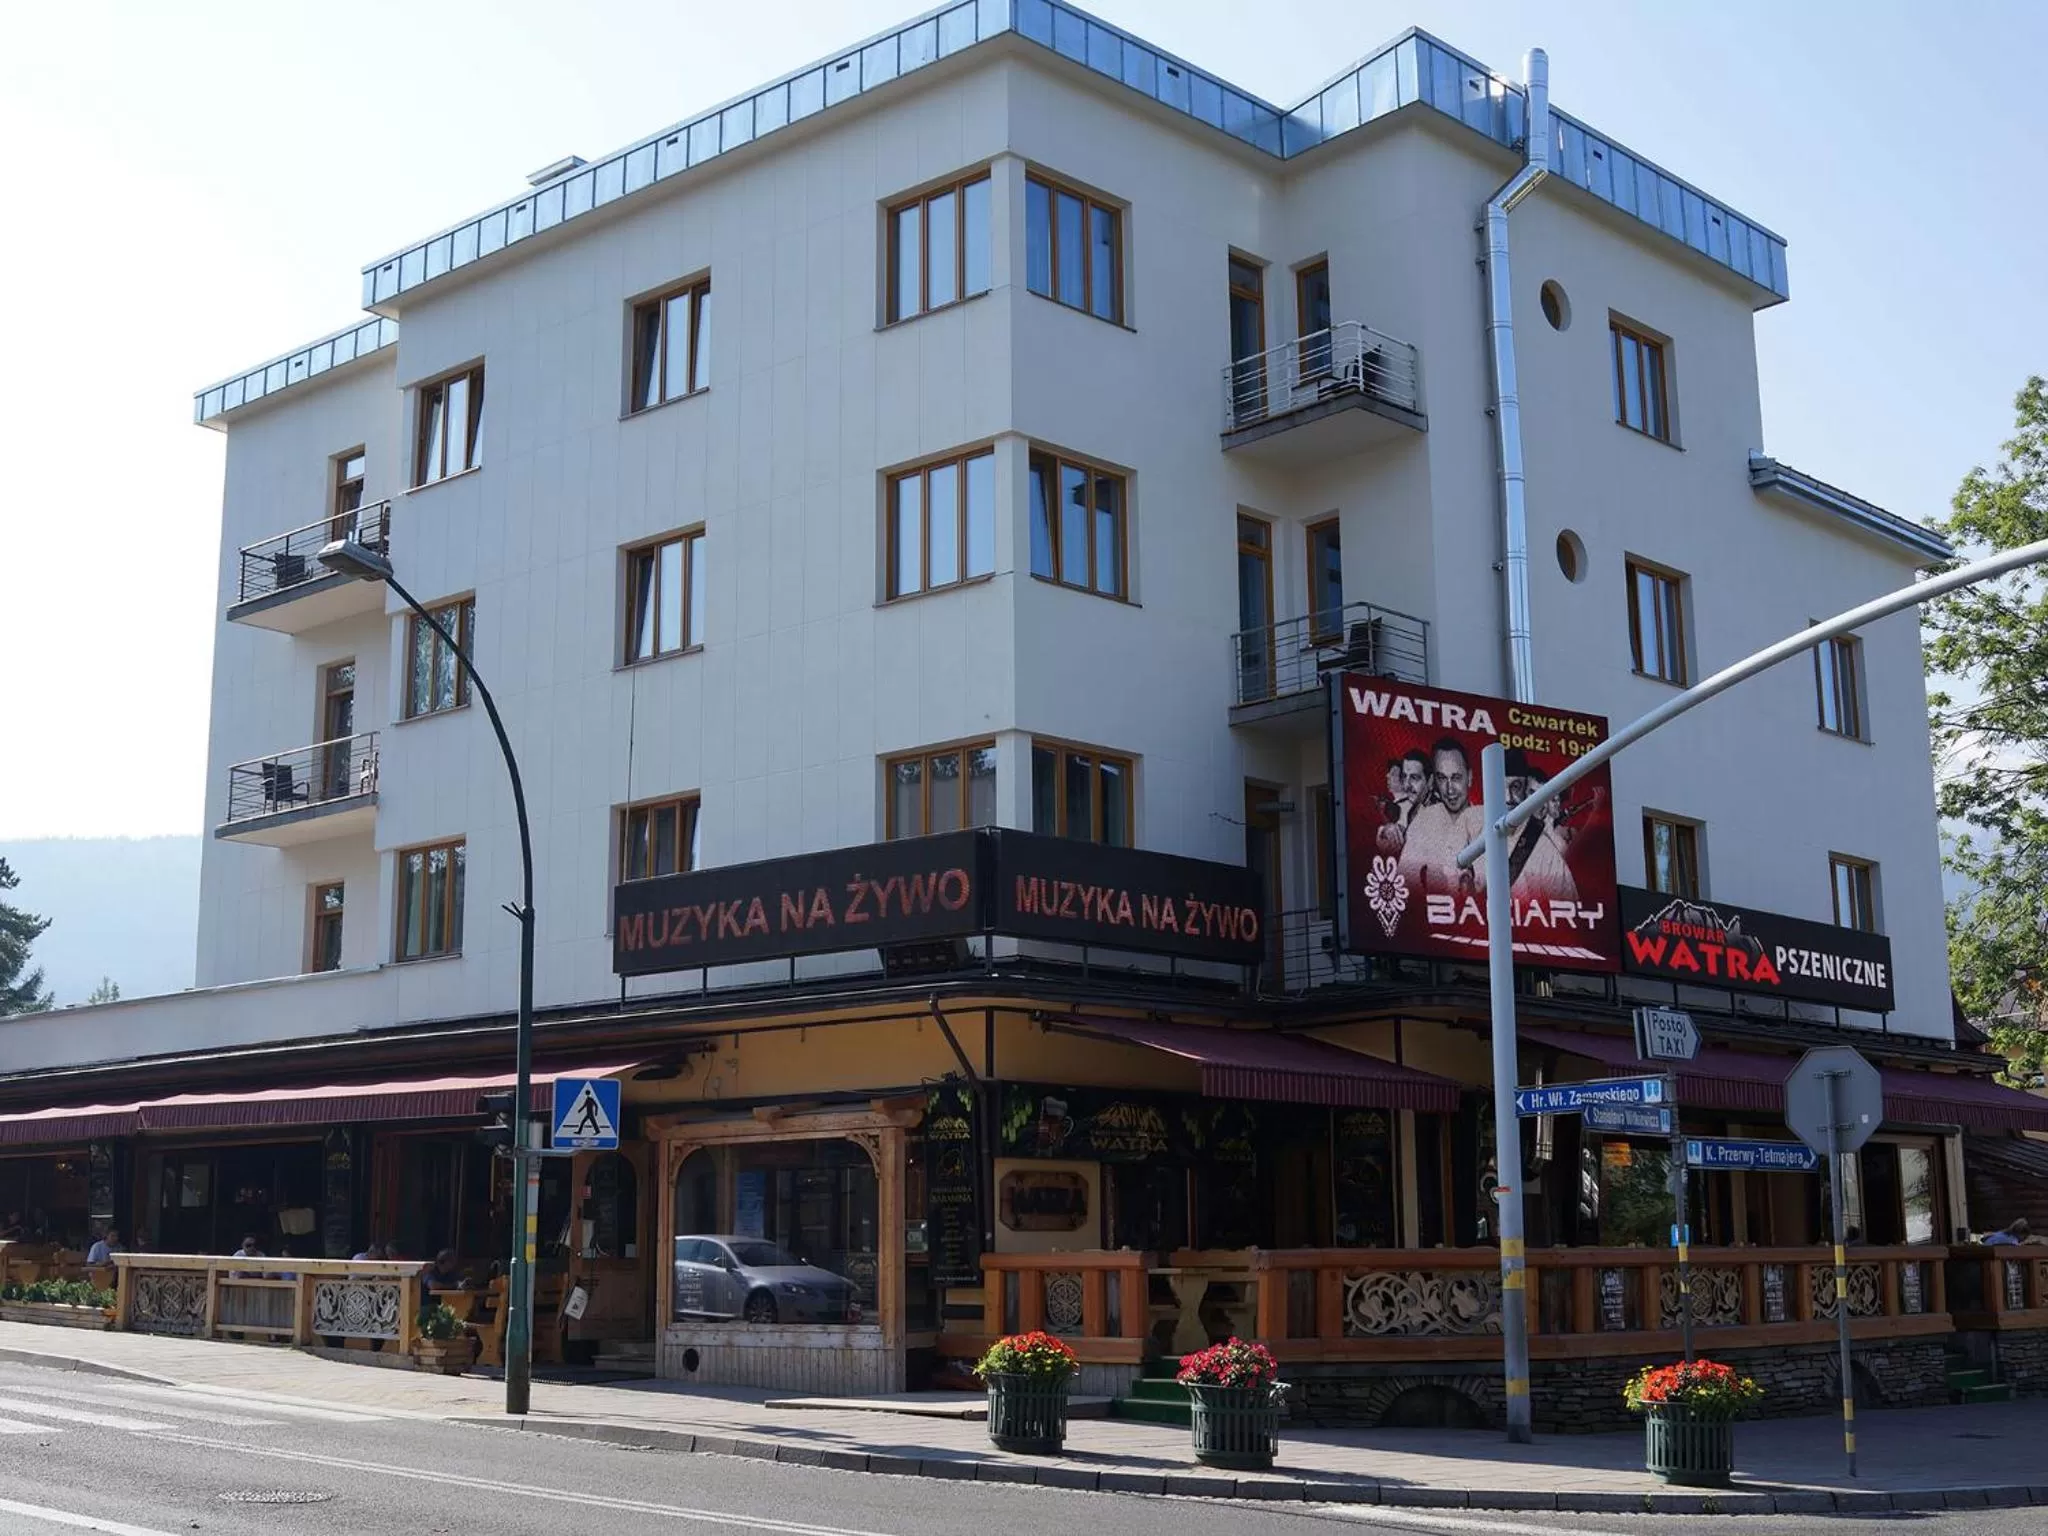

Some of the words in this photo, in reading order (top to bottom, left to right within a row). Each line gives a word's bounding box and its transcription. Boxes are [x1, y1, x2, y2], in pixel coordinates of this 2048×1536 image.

[1349, 687, 1497, 735] WATRA
[1508, 707, 1598, 738] Czwartek
[1500, 732, 1550, 752] godz:
[1557, 738, 1597, 757] 19:
[619, 896, 770, 951] MUZYKA
[780, 887, 836, 933] NA
[845, 868, 971, 924] ŻYWO
[1016, 875, 1135, 928] MUZYKA
[1141, 894, 1180, 933] NA
[1184, 892, 1258, 942] ŻYWO
[1426, 894, 1604, 930] BAIARY
[1660, 918, 1725, 945] BROWAR
[1625, 930, 1781, 985] WATRA
[1776, 945, 1887, 988] PSZENICZNE
[1652, 1012, 1687, 1038] Postój
[1658, 1035, 1686, 1056] TAXI
[1530, 1092, 1547, 1109] Hr.
[1548, 1091, 1567, 1108] Wł.
[928, 1131, 970, 1141] WATRA
[1089, 1136, 1168, 1153] WATRA
[1705, 1145, 1717, 1161] K.
[1718, 1145, 1804, 1166] Przerwy-Tetmajera
